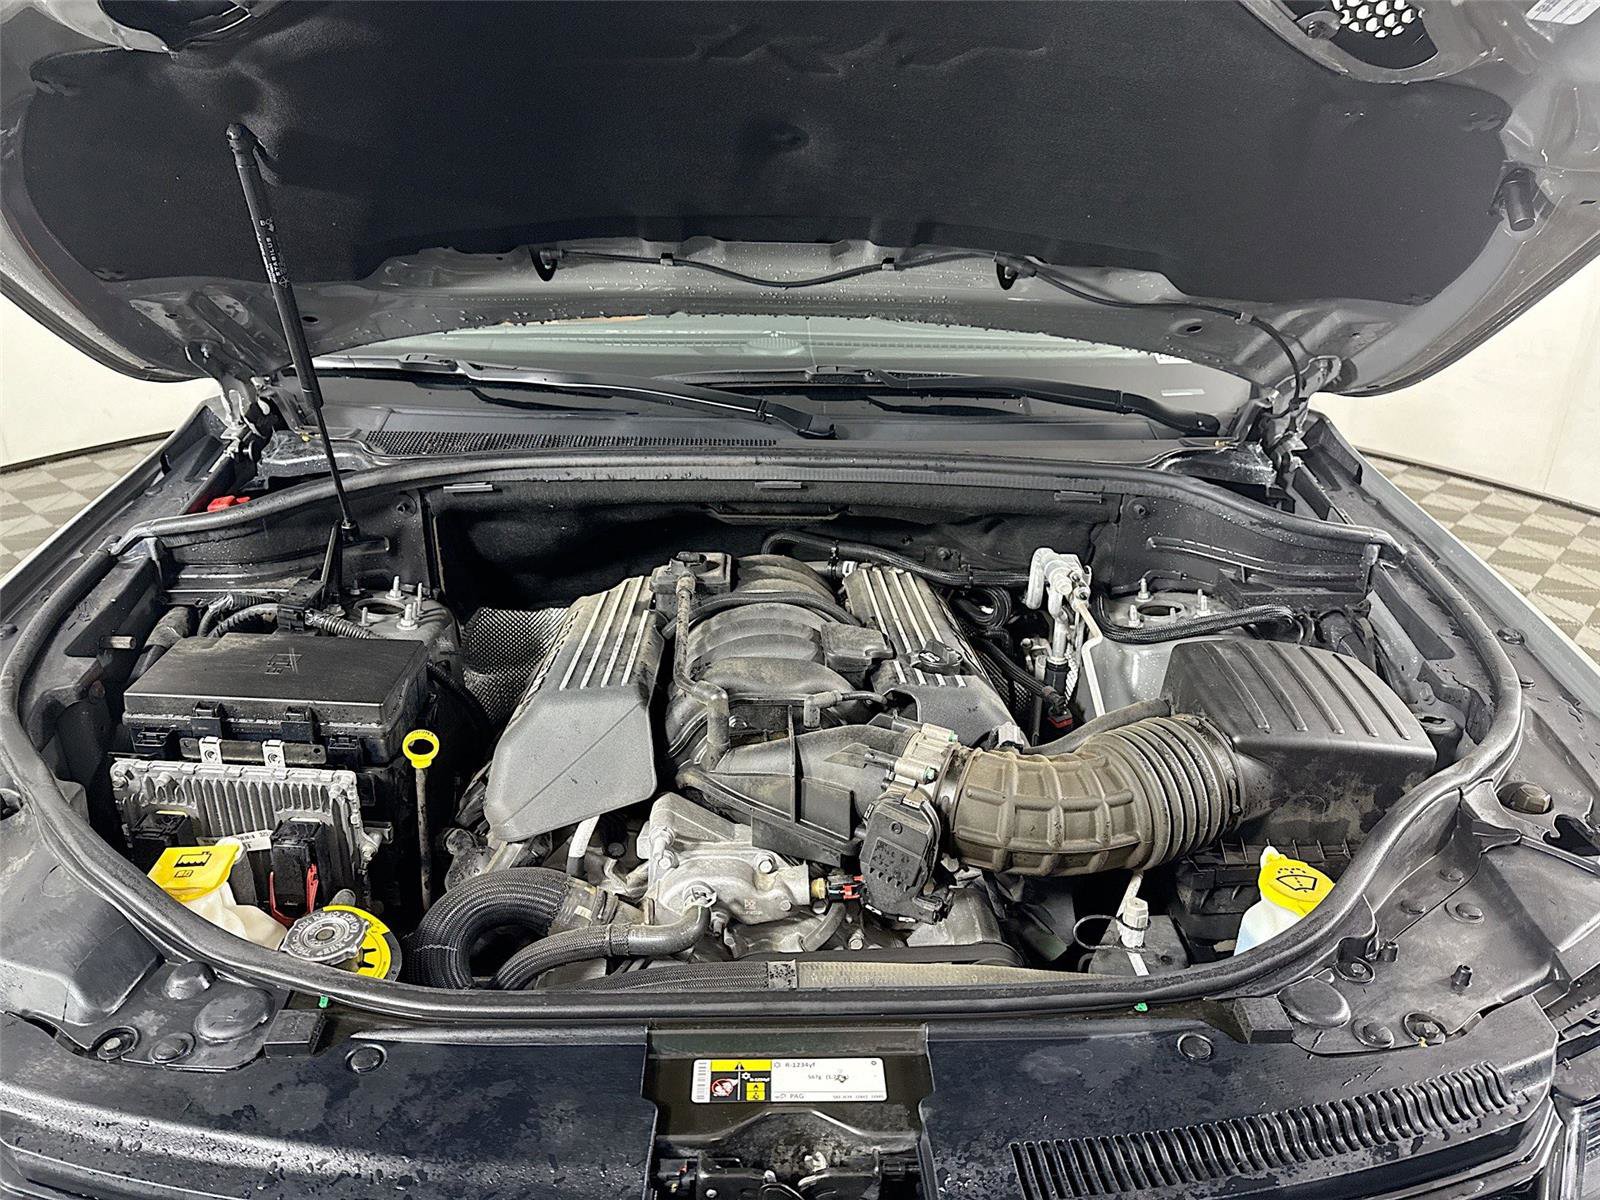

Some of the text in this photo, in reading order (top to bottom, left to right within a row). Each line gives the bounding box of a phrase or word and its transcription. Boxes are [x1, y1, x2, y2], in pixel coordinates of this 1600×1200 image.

[265, 237, 281, 277] STABILUS
[312, 911, 340, 920] OPEN
[294, 919, 312, 932] HOT
